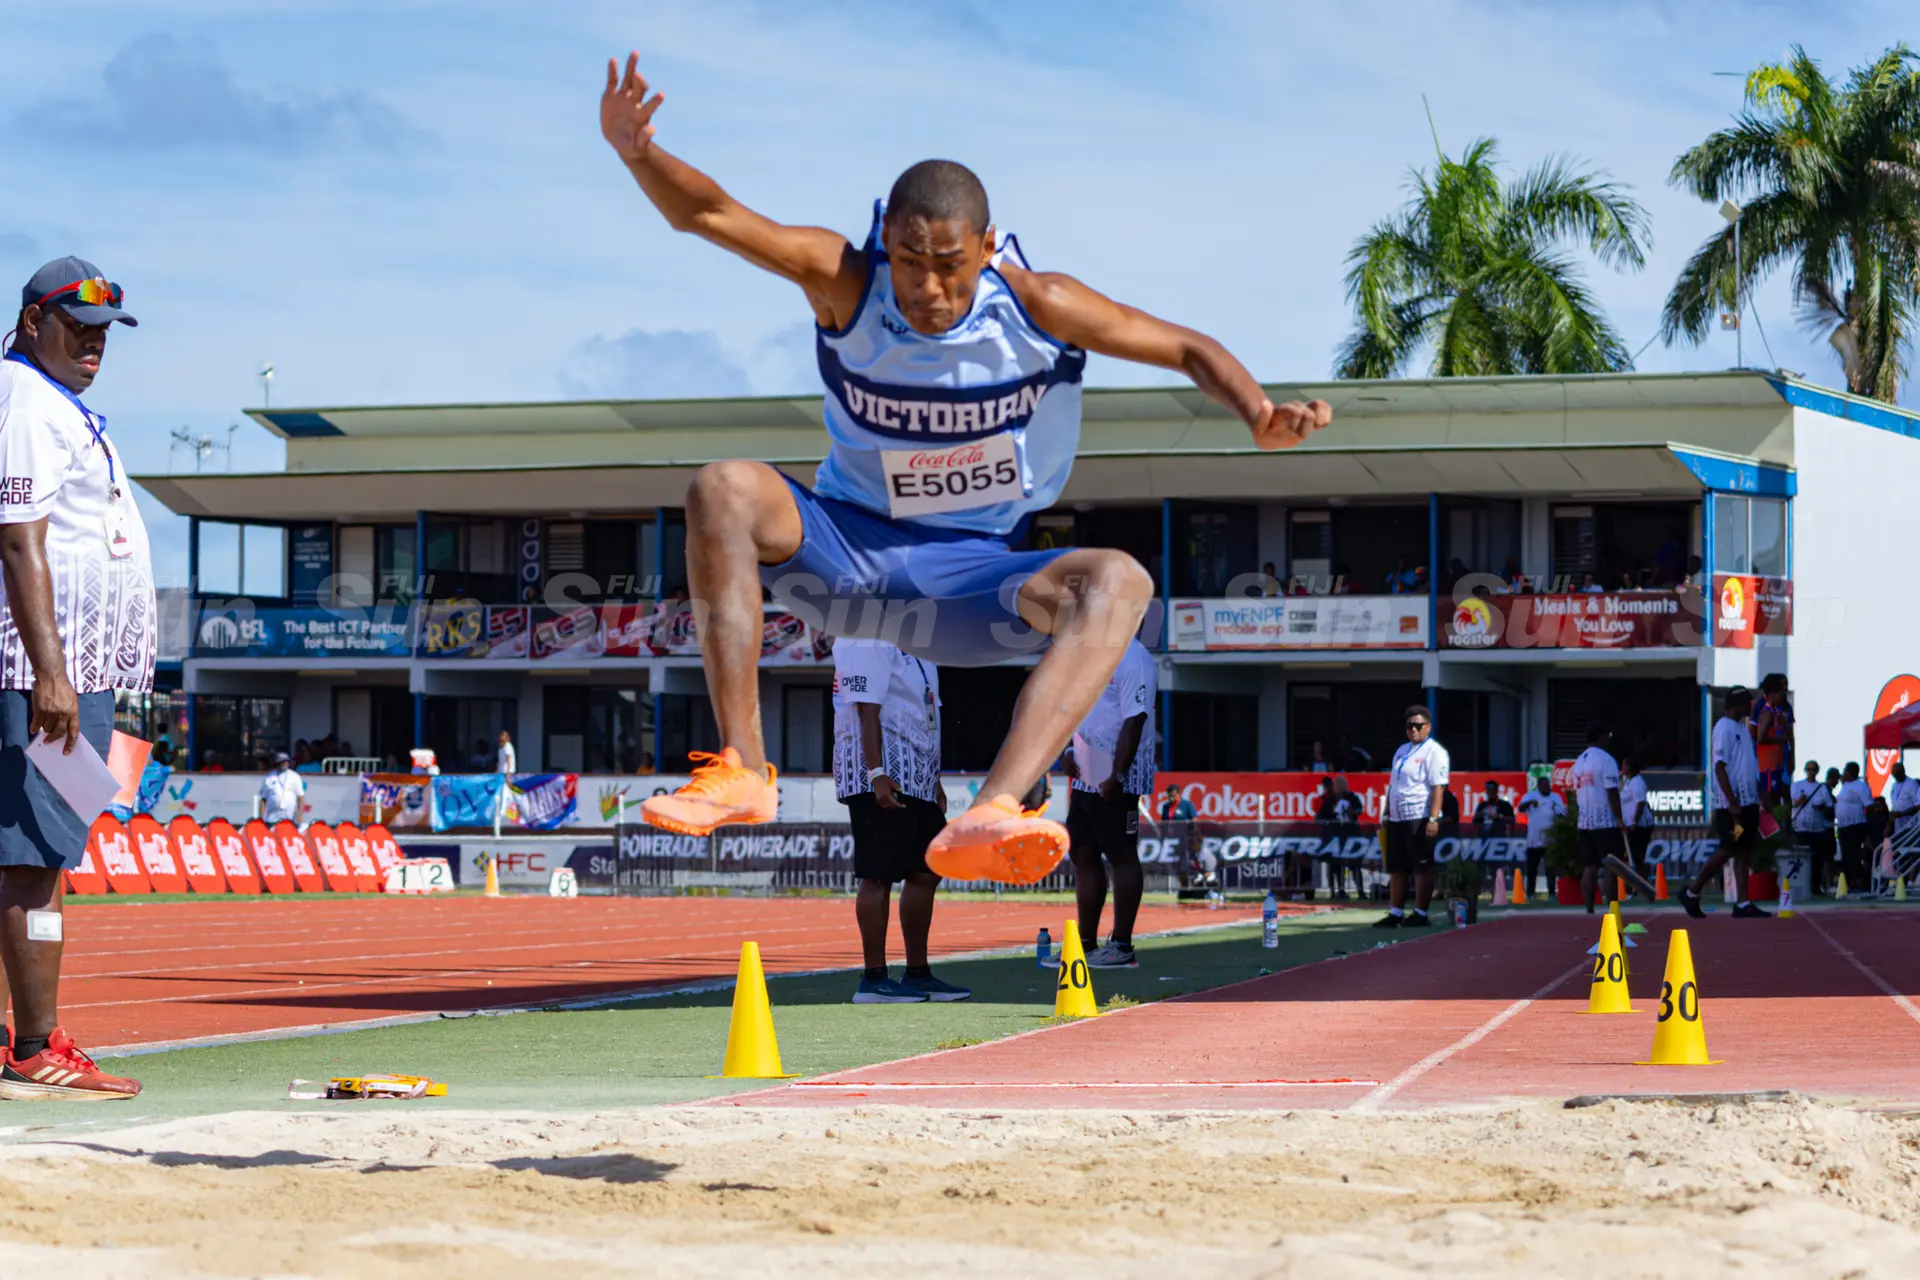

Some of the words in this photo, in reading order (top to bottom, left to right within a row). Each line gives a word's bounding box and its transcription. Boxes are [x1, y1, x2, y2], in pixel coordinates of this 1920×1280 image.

[842, 380, 1048, 435] VICTORIAN
[892, 458, 1017, 498] E5055
[1534, 597, 1581, 616] Meals
[1604, 597, 1678, 615] Moments
[283, 620, 306, 634] The
[308, 620, 335, 635] Best
[338, 620, 360, 635] ICT
[361, 620, 407, 636] Partner
[1573, 617, 1599, 633] You
[1601, 617, 1635, 633] Love
[304, 636, 323, 649] for
[325, 636, 345, 649] the
[347, 636, 387, 649] Future
[1448, 632, 1499, 645] rooster
[1181, 782, 1259, 817] Coke
[619, 834, 708, 860] POWERADE
[719, 834, 822, 861] POWERADE
[1198, 836, 1383, 861] POWERADE
[496, 853, 546, 873] HFC
[399, 867, 407, 888] 1
[430, 864, 443, 885] 2
[559, 873, 570, 892] 6
[1057, 959, 1088, 990] 20
[1592, 952, 1624, 983] 20
[1657, 981, 1699, 1023] 30
